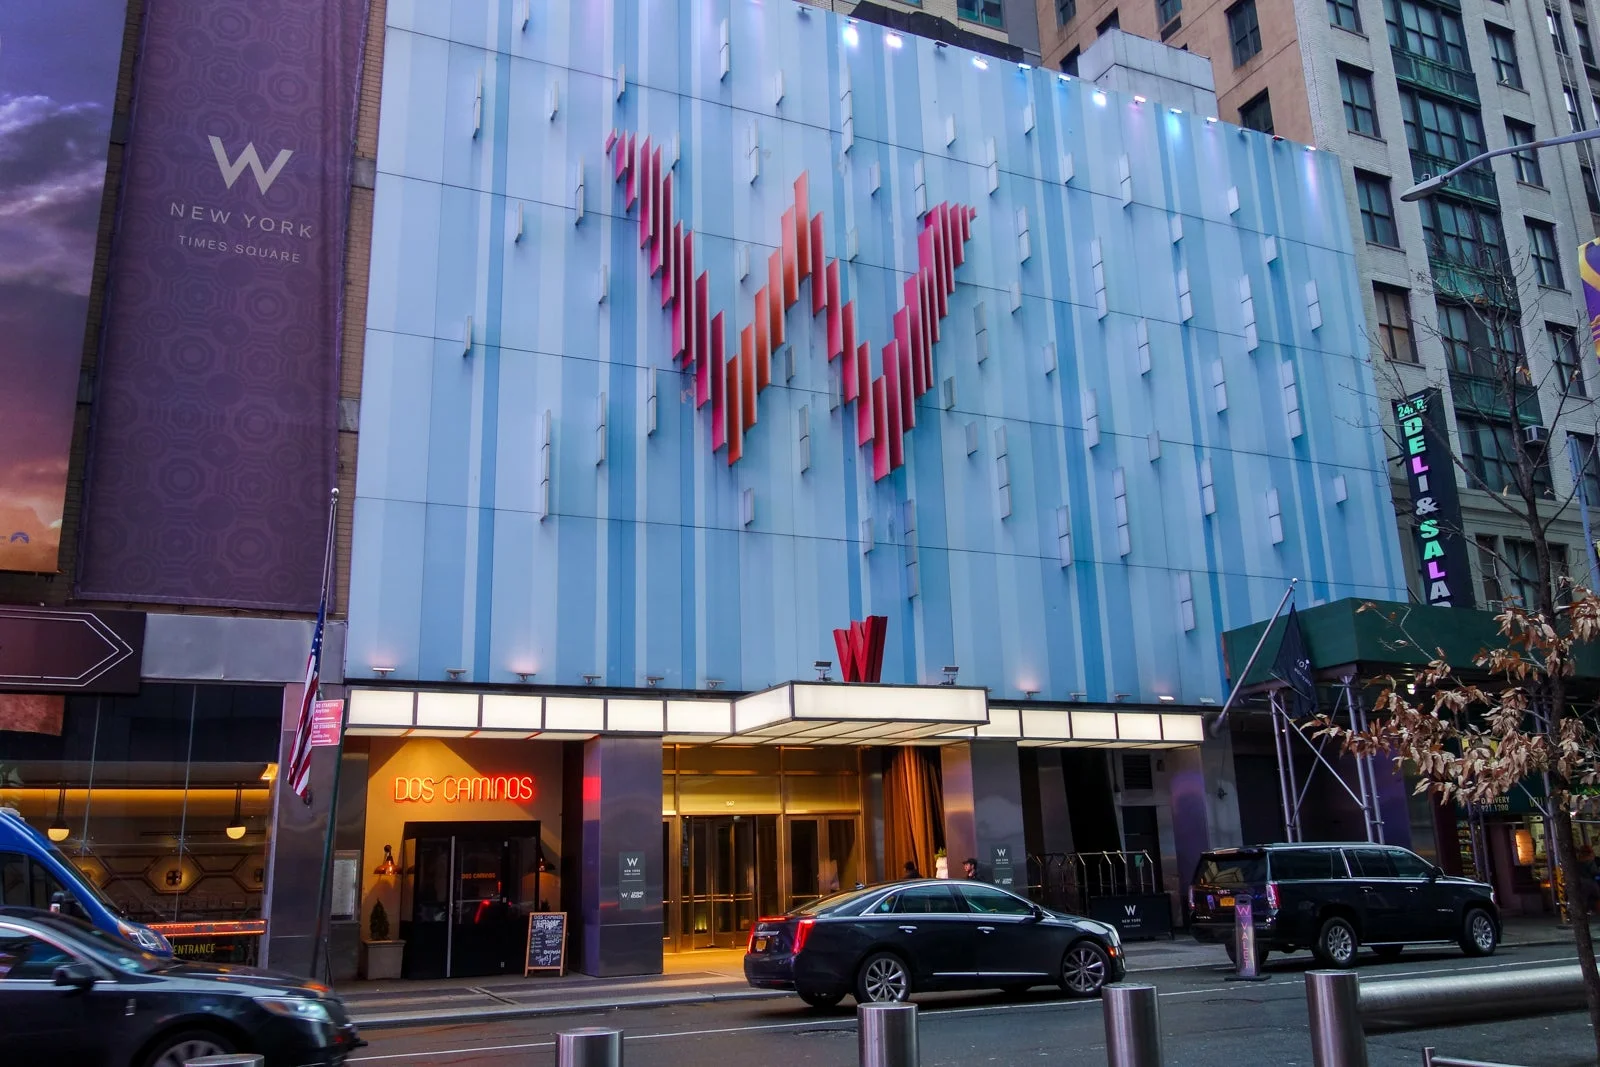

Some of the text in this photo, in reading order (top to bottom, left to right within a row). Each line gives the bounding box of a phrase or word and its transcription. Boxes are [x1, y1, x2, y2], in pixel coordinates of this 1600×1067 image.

[207, 134, 295, 196] W
[170, 202, 313, 239] NEW YORK
[179, 234, 301, 264] TIMES SQUARE
[1404, 417, 1429, 492] DELI
[1419, 519, 1451, 607] SALA
[832, 614, 888, 683] W
[395, 776, 533, 801] DOS CAMINOS
[627, 857, 639, 867] W
[996, 848, 1006, 857] W
[1124, 904, 1137, 916] W
[1236, 905, 1251, 915] W
[174, 943, 216, 955] ENTRANCE
[1241, 922, 1249, 969] VALET
